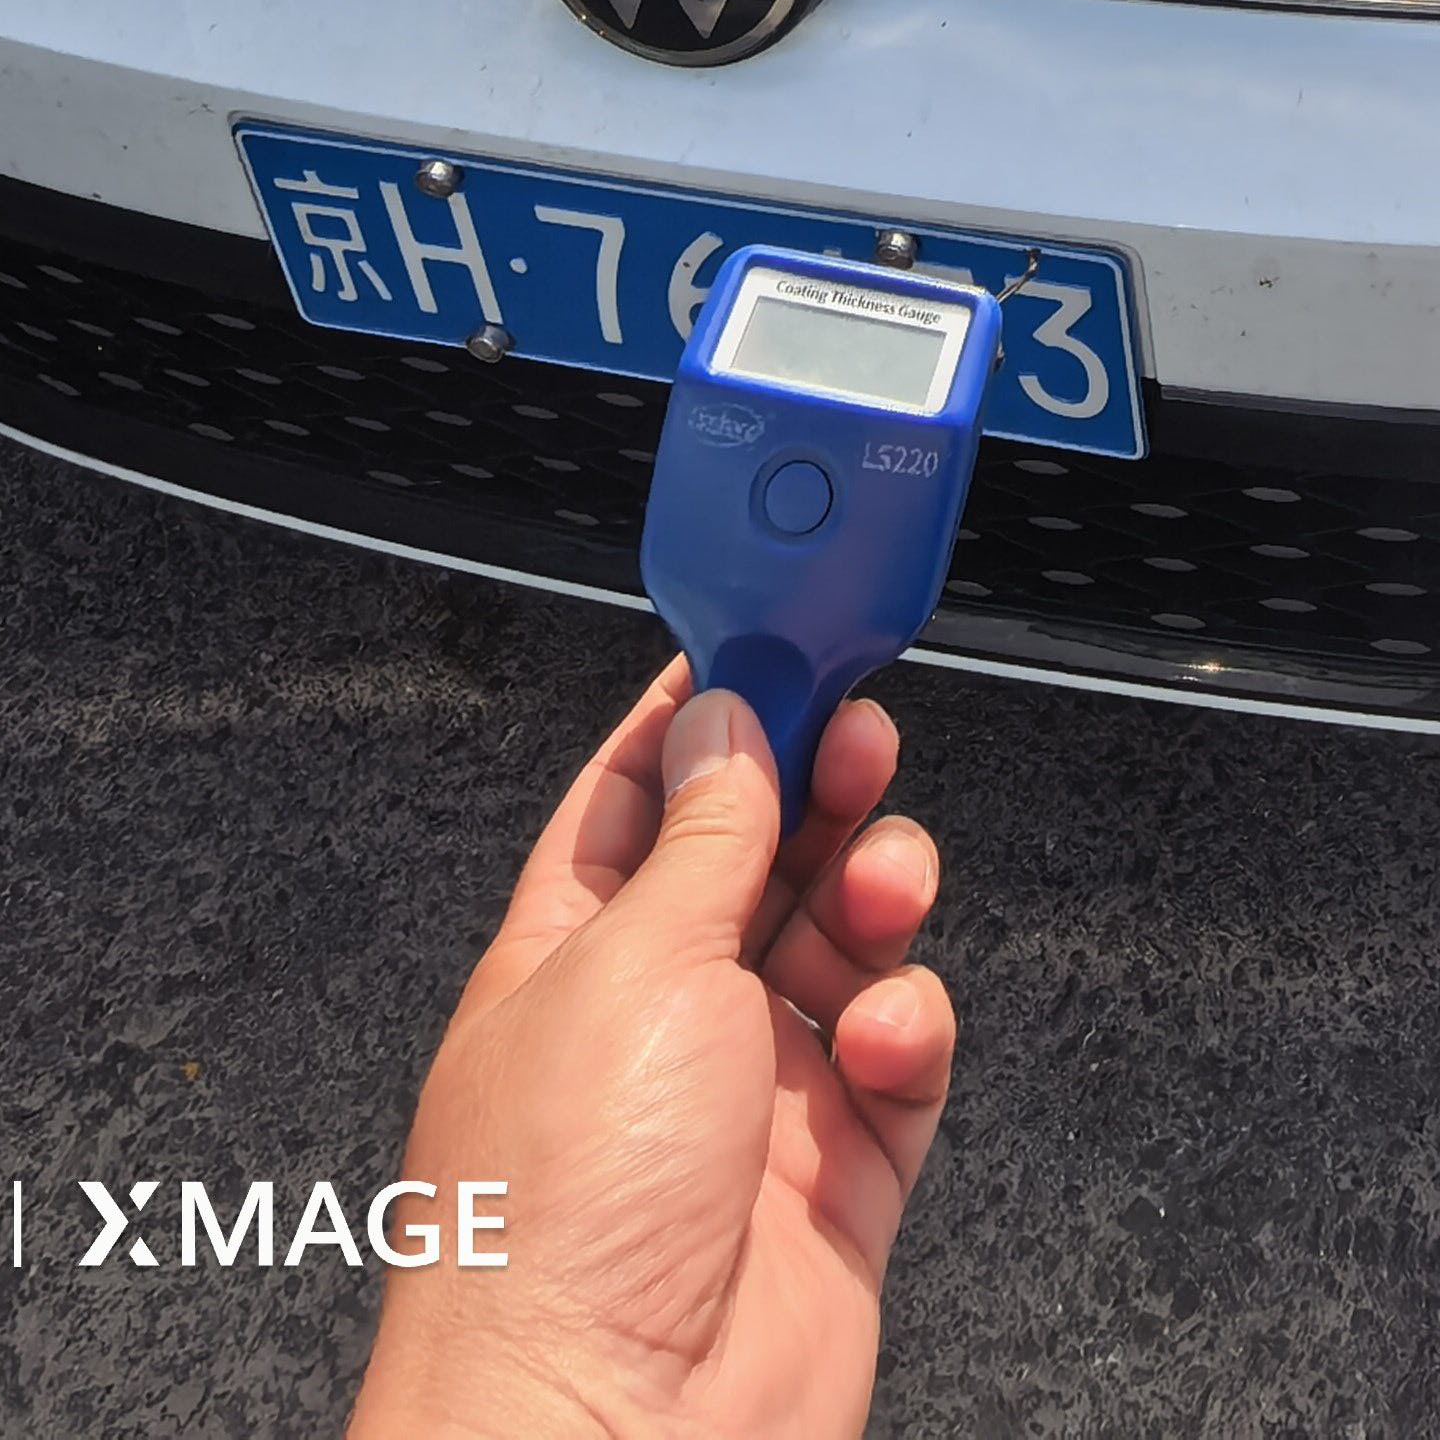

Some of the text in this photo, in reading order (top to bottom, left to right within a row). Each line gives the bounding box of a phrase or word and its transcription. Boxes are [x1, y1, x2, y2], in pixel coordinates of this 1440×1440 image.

[273, 170, 1110, 420] 京H·763
[776, 280, 942, 325] Coating Thickness Gauge
[862, 441, 939, 477] LS220
